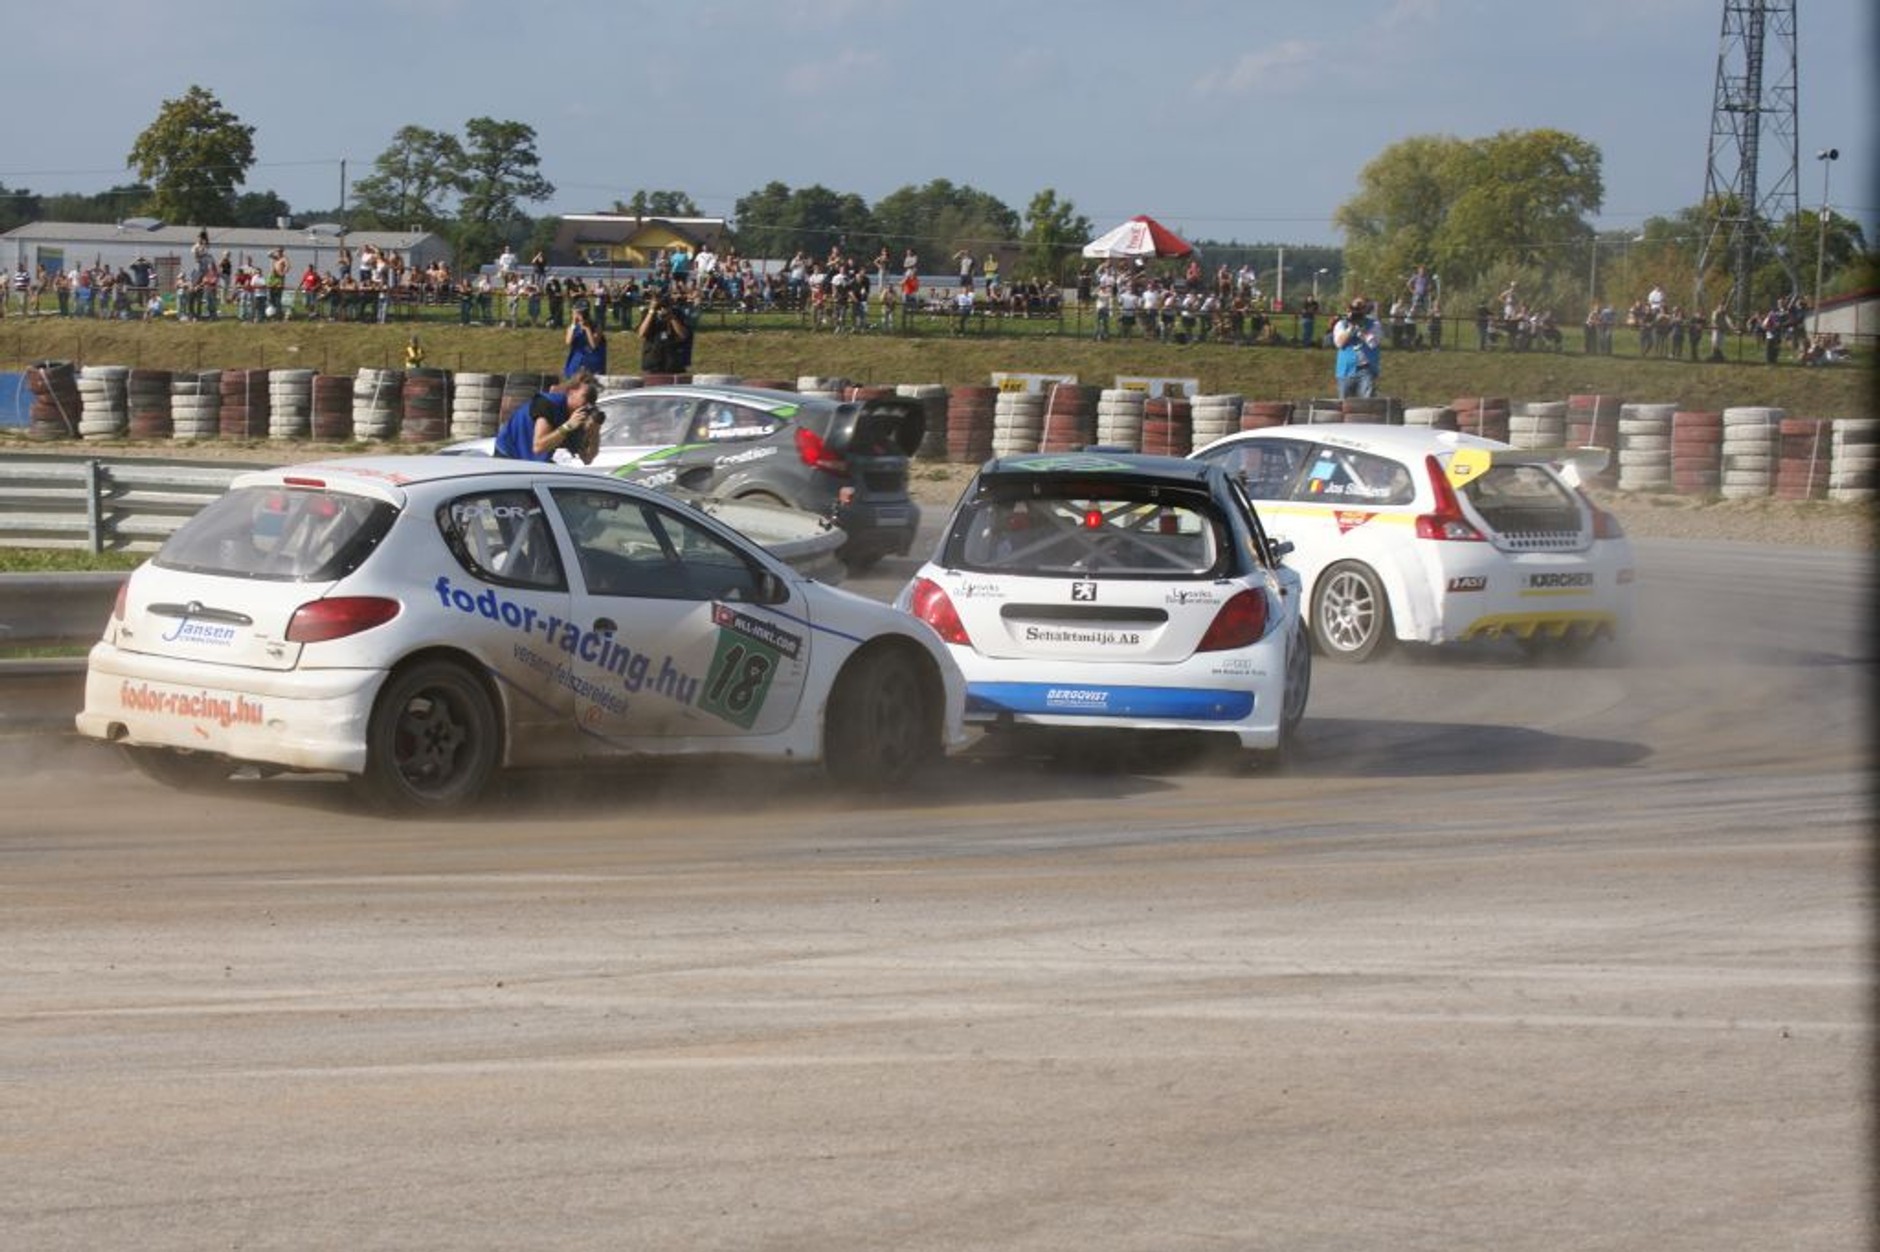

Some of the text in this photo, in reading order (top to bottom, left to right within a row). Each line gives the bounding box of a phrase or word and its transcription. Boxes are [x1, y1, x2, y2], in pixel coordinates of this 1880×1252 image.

[455, 505, 525, 518] FODOR
[161, 615, 236, 641] Jansen
[435, 576, 700, 706] fodor-racing.hu
[1120, 633, 1140, 645] AB
[709, 643, 770, 712] 18
[120, 680, 264, 728] fodor-racing.hu
